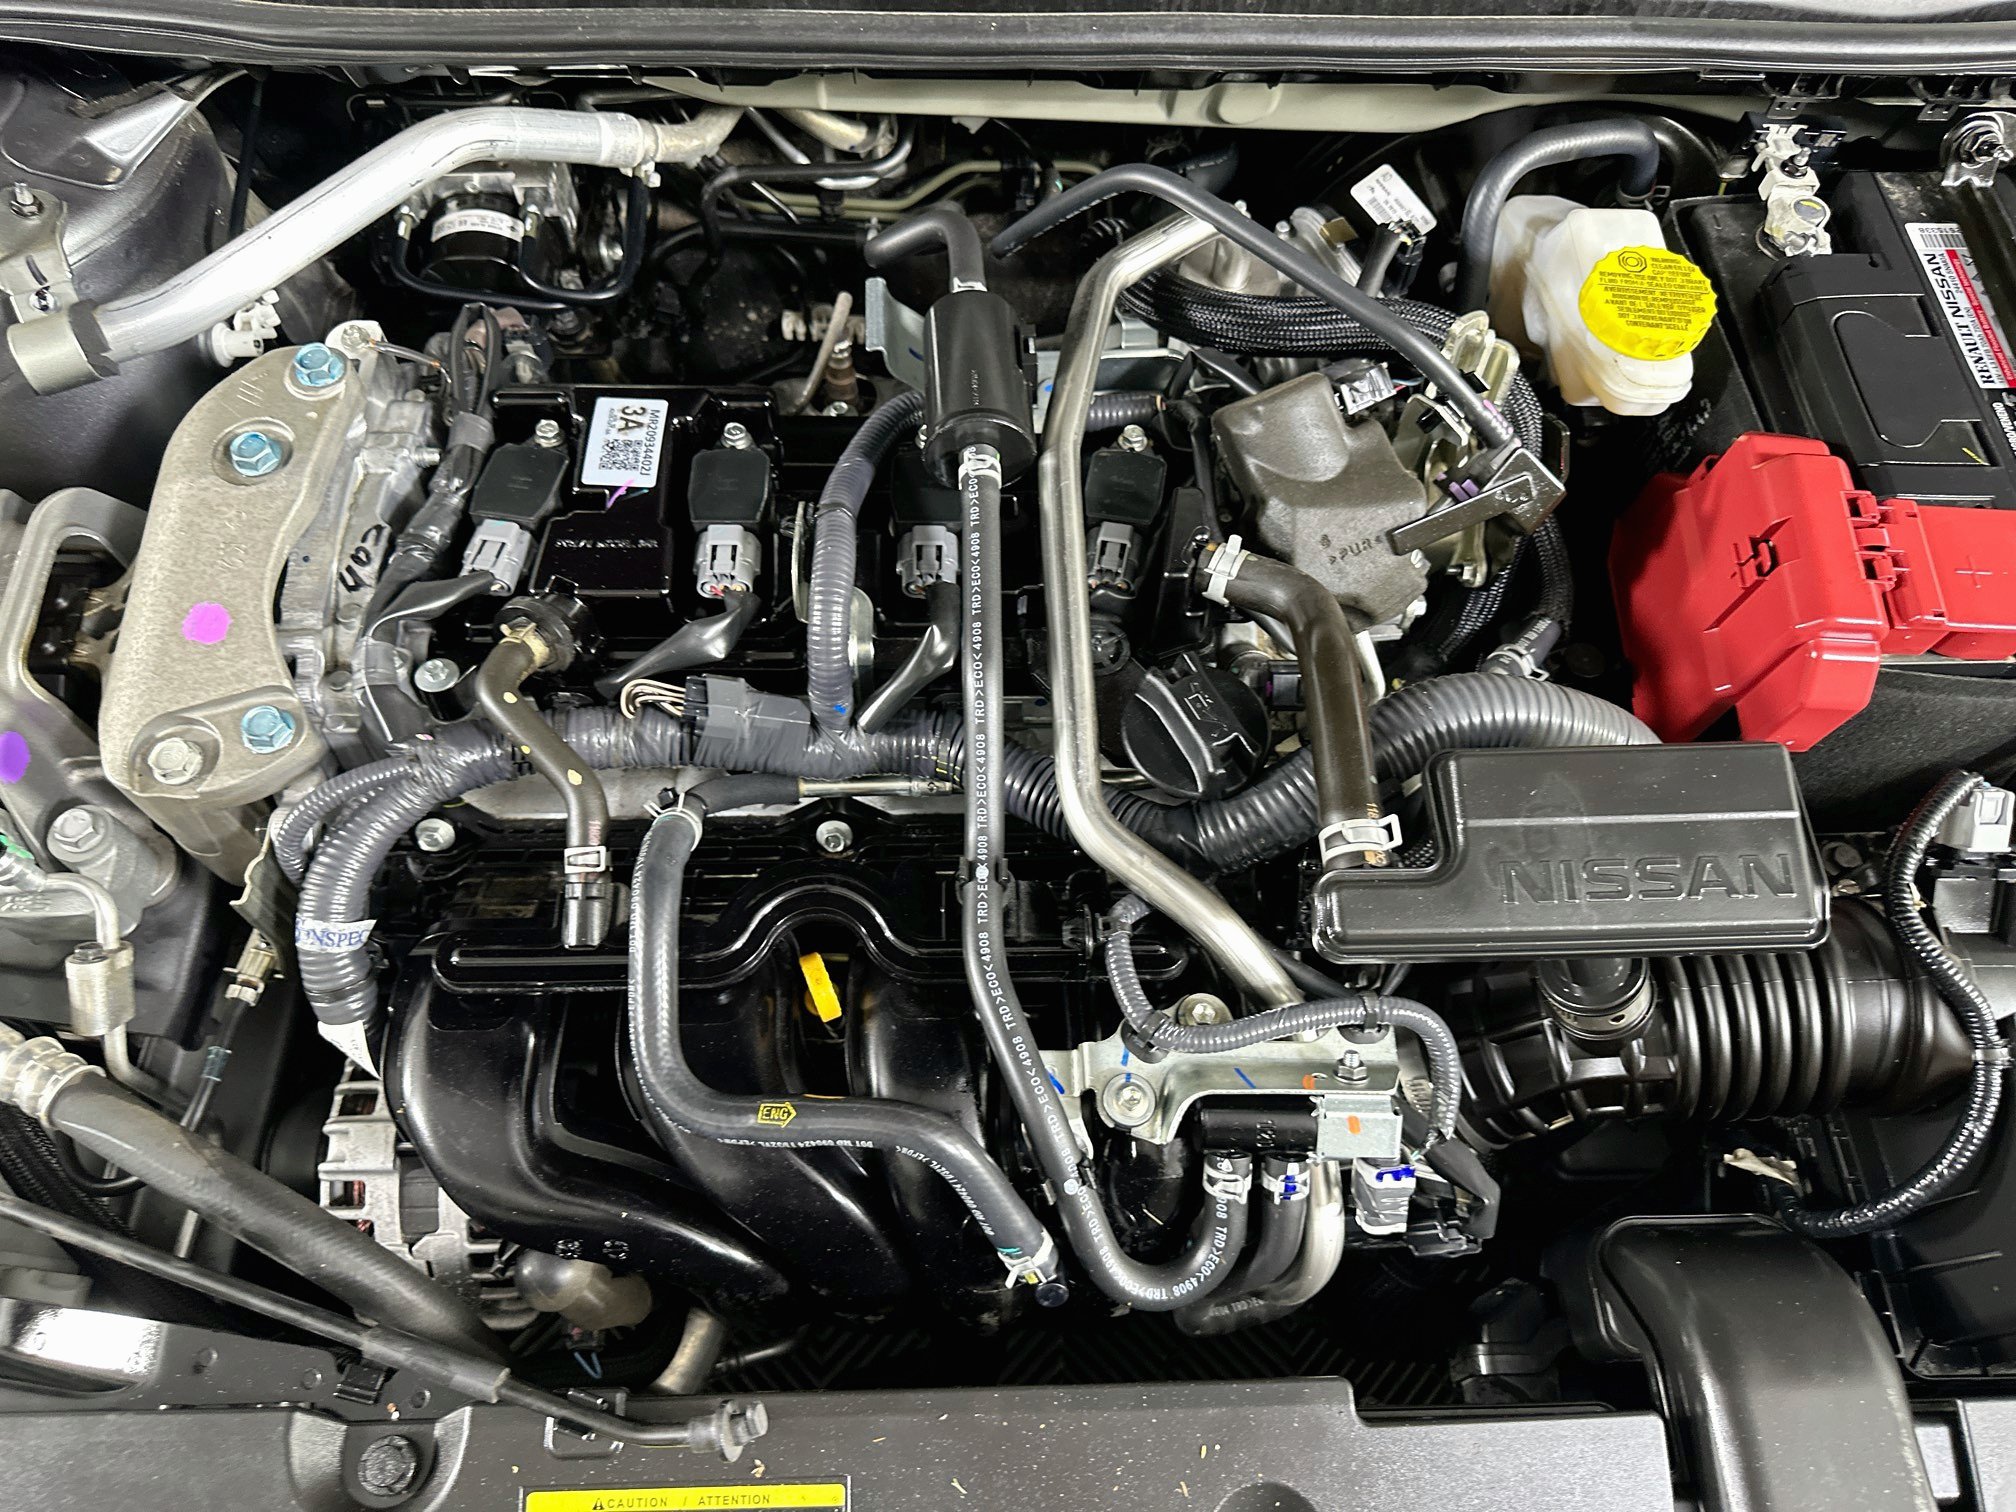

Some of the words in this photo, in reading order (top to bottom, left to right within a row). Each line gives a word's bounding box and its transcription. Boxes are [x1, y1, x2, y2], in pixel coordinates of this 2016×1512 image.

[1923, 253, 1964, 317] NISSAN
[1955, 322, 1995, 383] RENAULT
[618, 406, 647, 434] 3A
[640, 409, 661, 476] MR20934402J
[968, 531, 982, 616] TRD>ECO<4908
[972, 621, 985, 724] TRD>ECO<4908
[975, 733, 988, 829] TRD>ECO<4908
[1499, 853, 1797, 905] NISSAN
[978, 931, 1018, 1030] TRD>ECO<4908
[762, 1107, 788, 1120] ENG
[1010, 1035, 1063, 1141] TRD>ECO<4908
[1172, 1226, 1228, 1297] TRD>ECO<4908
[607, 1496, 669, 1509] CAUTION
[698, 1493, 771, 1507] ATTENTION
